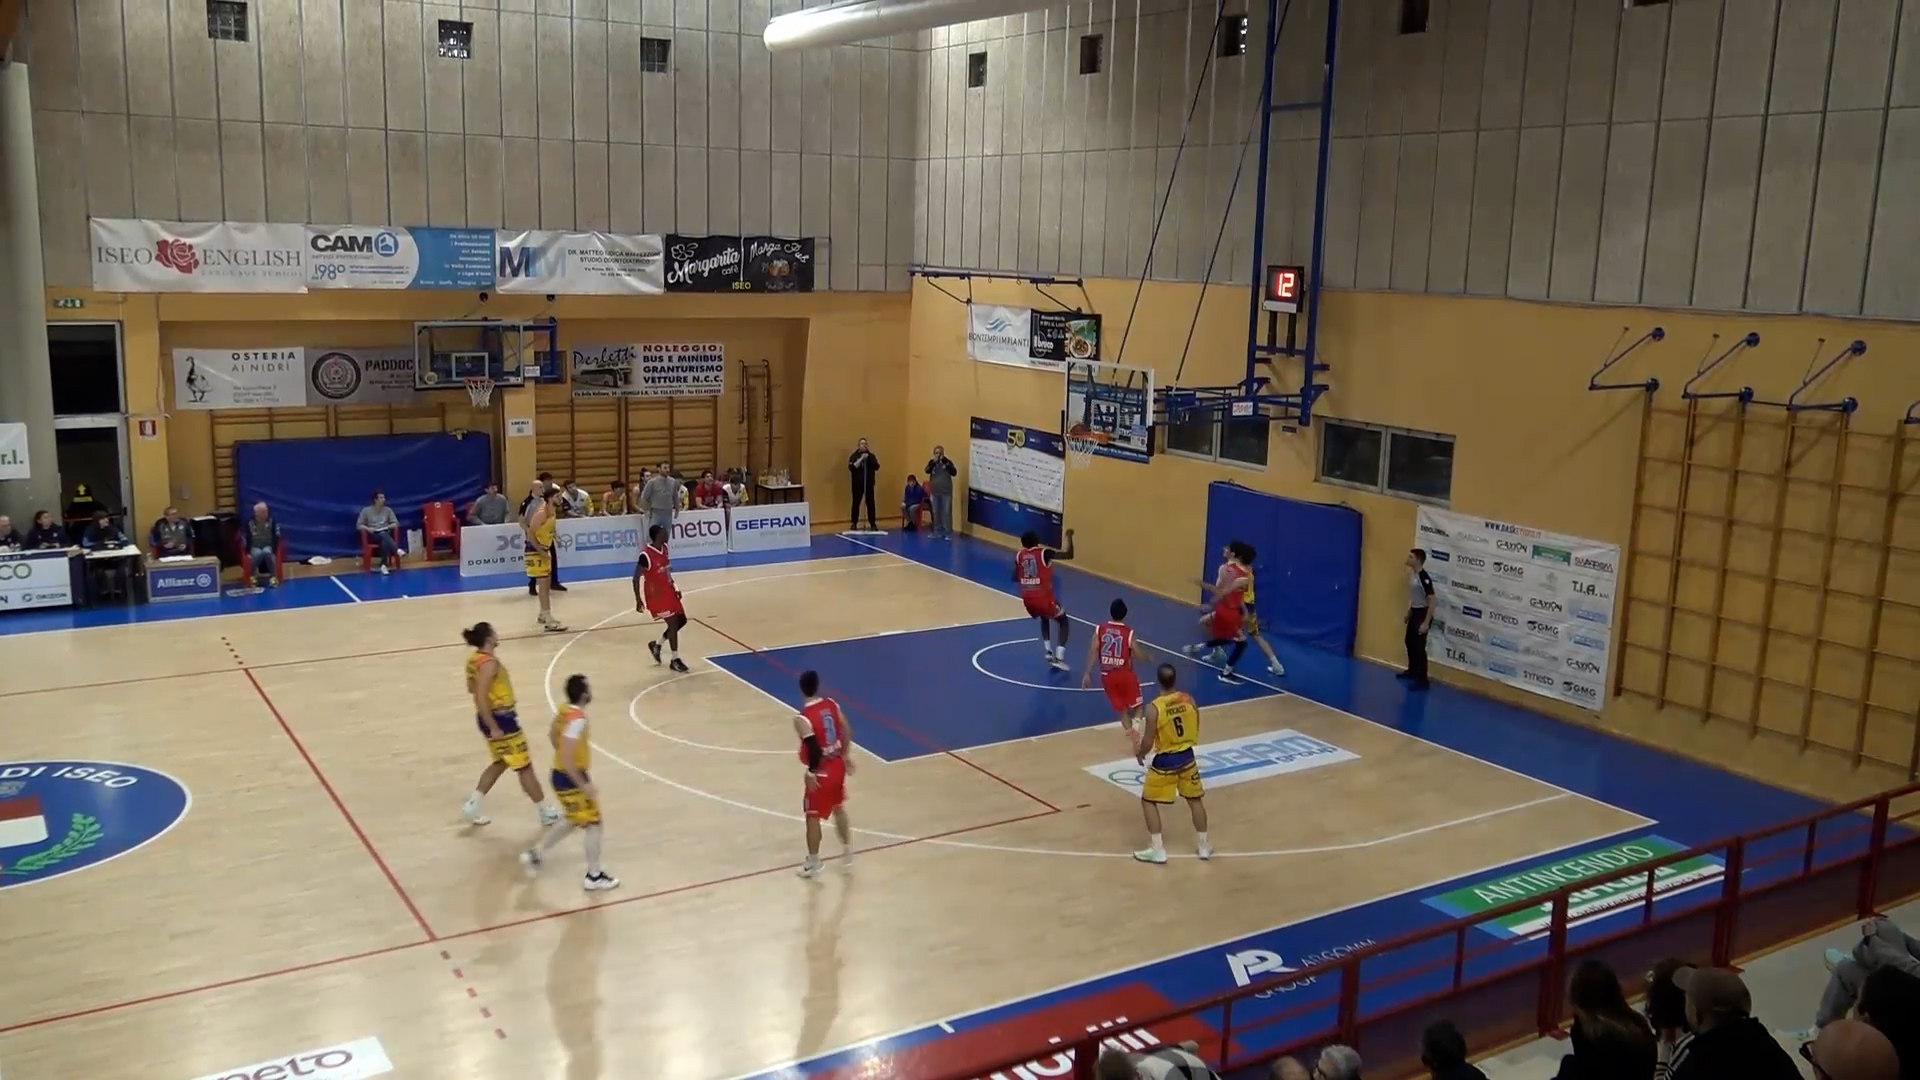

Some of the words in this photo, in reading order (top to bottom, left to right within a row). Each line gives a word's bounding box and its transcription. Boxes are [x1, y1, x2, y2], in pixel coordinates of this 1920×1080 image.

[310, 235, 373, 253] CAM
[97, 246, 153, 265] ISEO
[202, 248, 301, 267] ENGLISH
[666, 248, 740, 284] Margarita
[732, 281, 751, 290] ISEO
[1278, 272, 1295, 298] 12
[231, 352, 296, 361] OSTERIA
[572, 346, 637, 370] Perletti
[643, 355, 664, 363] BUS
[677, 355, 723, 363] MINIBUS
[643, 365, 724, 374] GRANTURISMO
[643, 375, 688, 384] VETTURE
[692, 374, 723, 383] N.C.C.
[735, 516, 806, 531] GEFRAN
[467, 557, 506, 567] DOMUS
[157, 577, 196, 589] Allianz
[1101, 633, 1123, 658] 21
[1173, 716, 1185, 738] 6
[0, 766, 48, 779] DI
[51, 766, 138, 788] ISEO
[1472, 844, 1654, 904] ANTINCENDIO
